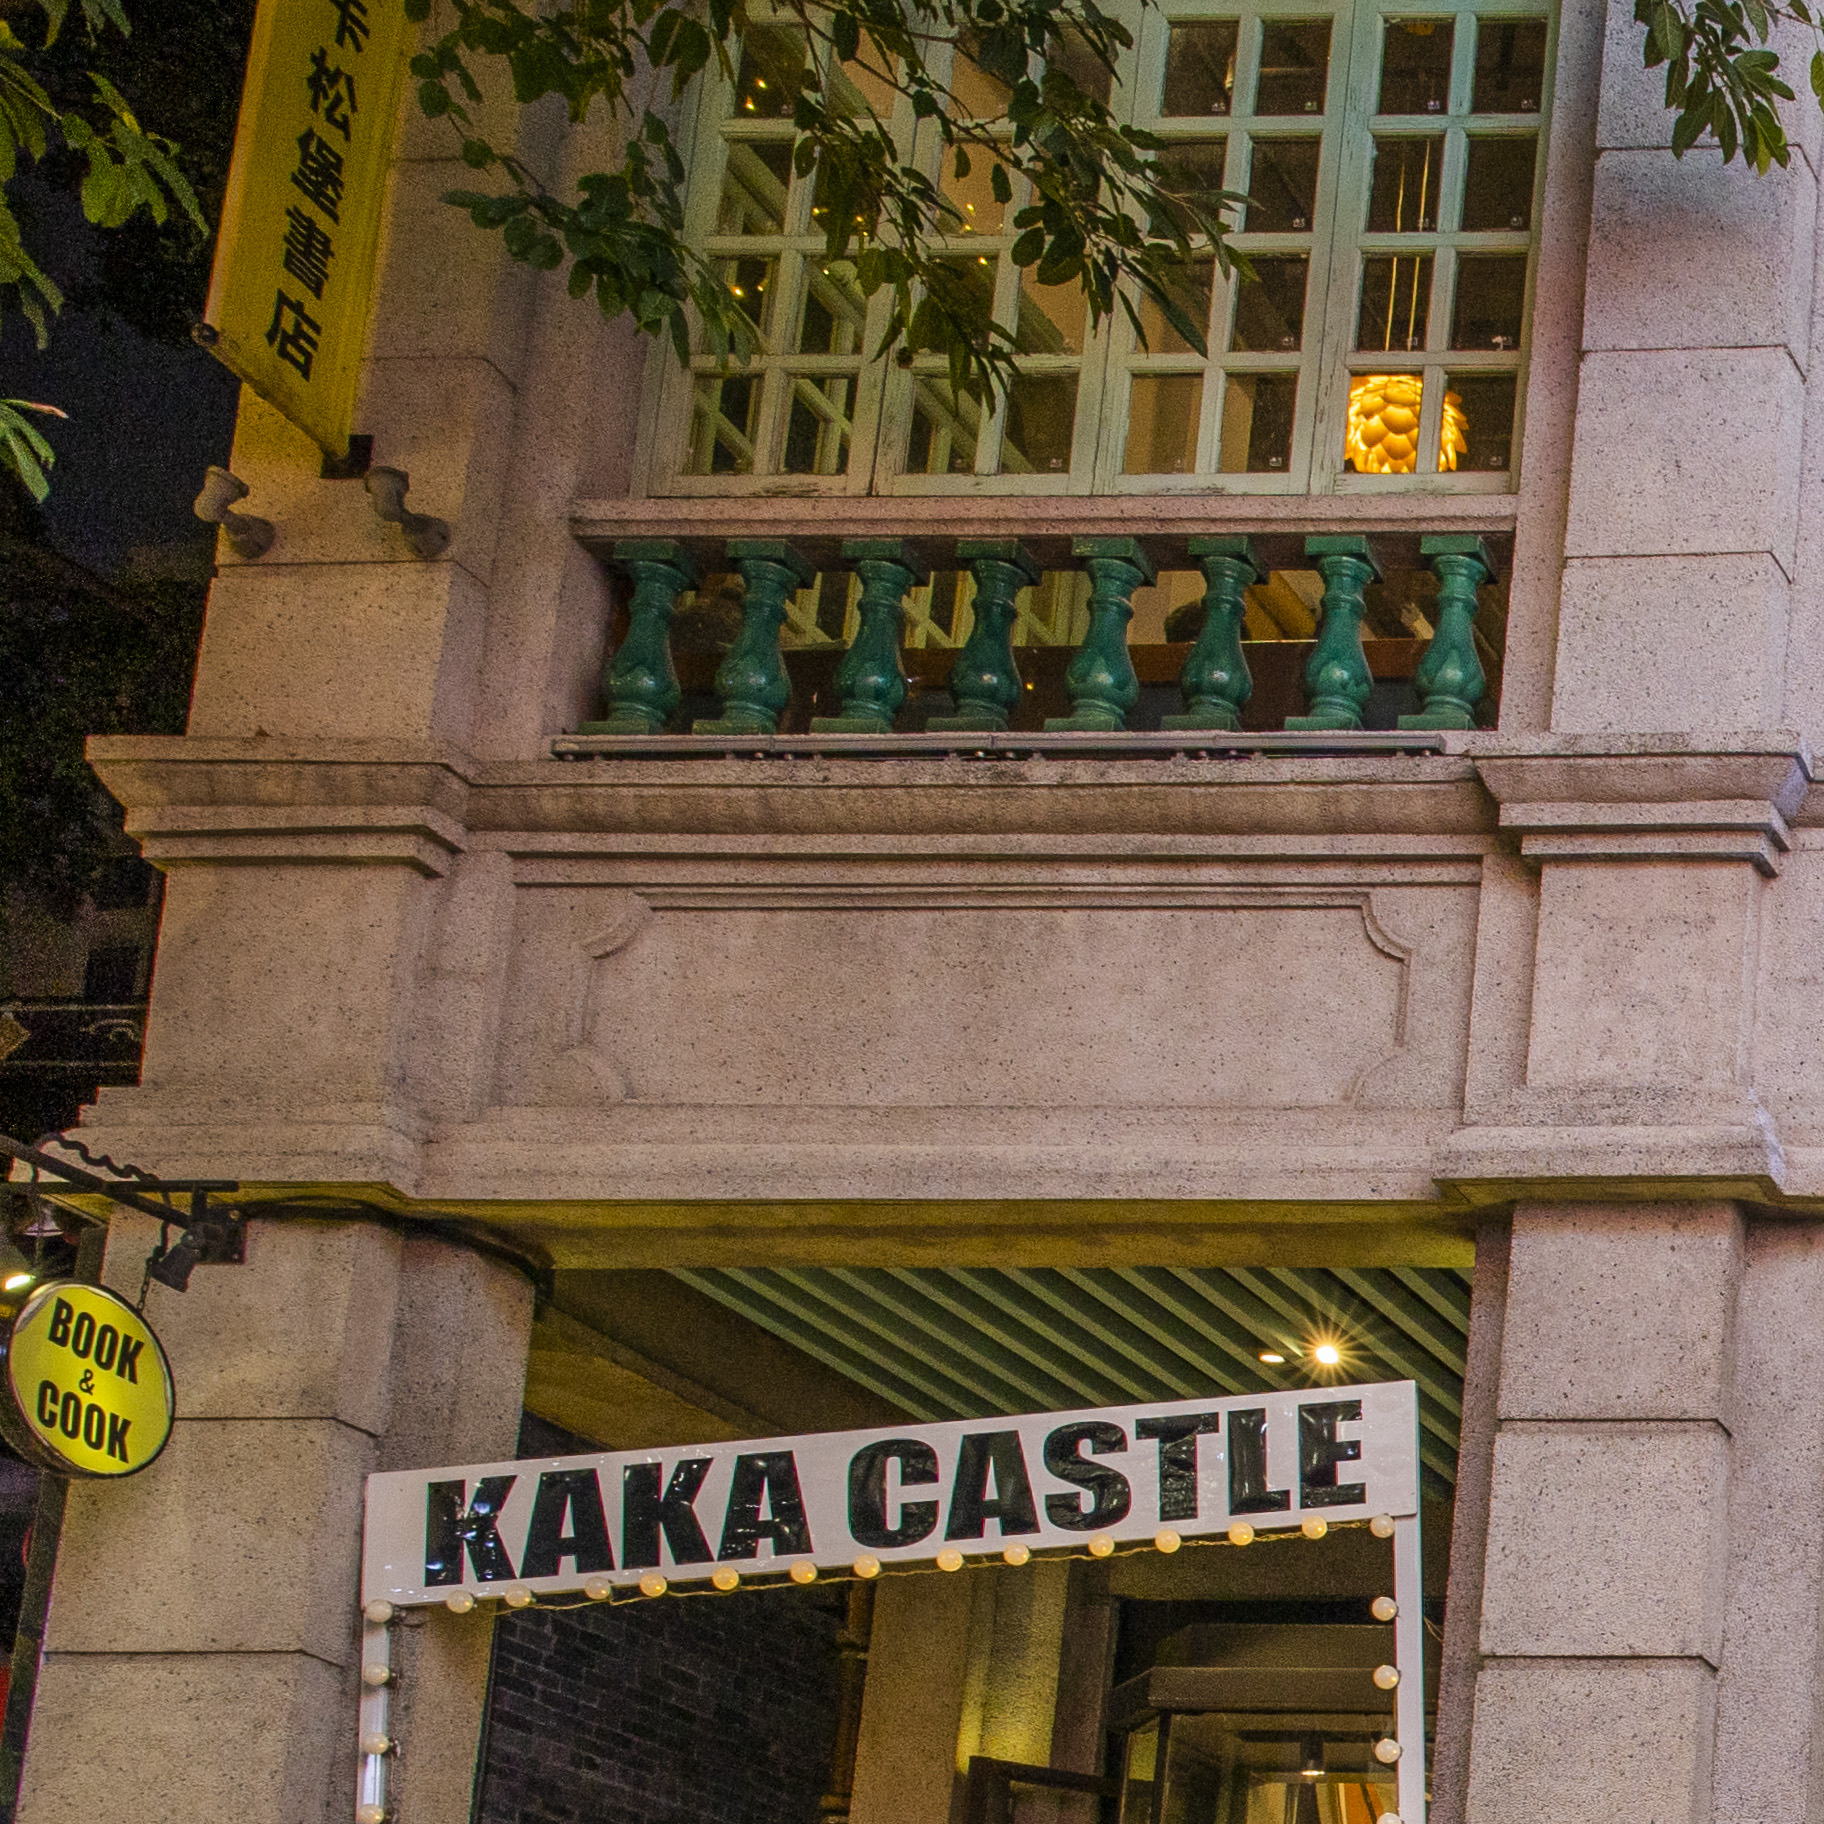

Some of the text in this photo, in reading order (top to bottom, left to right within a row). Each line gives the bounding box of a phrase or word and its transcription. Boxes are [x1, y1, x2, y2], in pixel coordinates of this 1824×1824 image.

[48, 1297, 145, 1385] BOOK
[79, 1369, 95, 1395] &
[37, 1380, 132, 1464] COOK
[424, 1400, 1367, 1587] KAKA CASTLE
